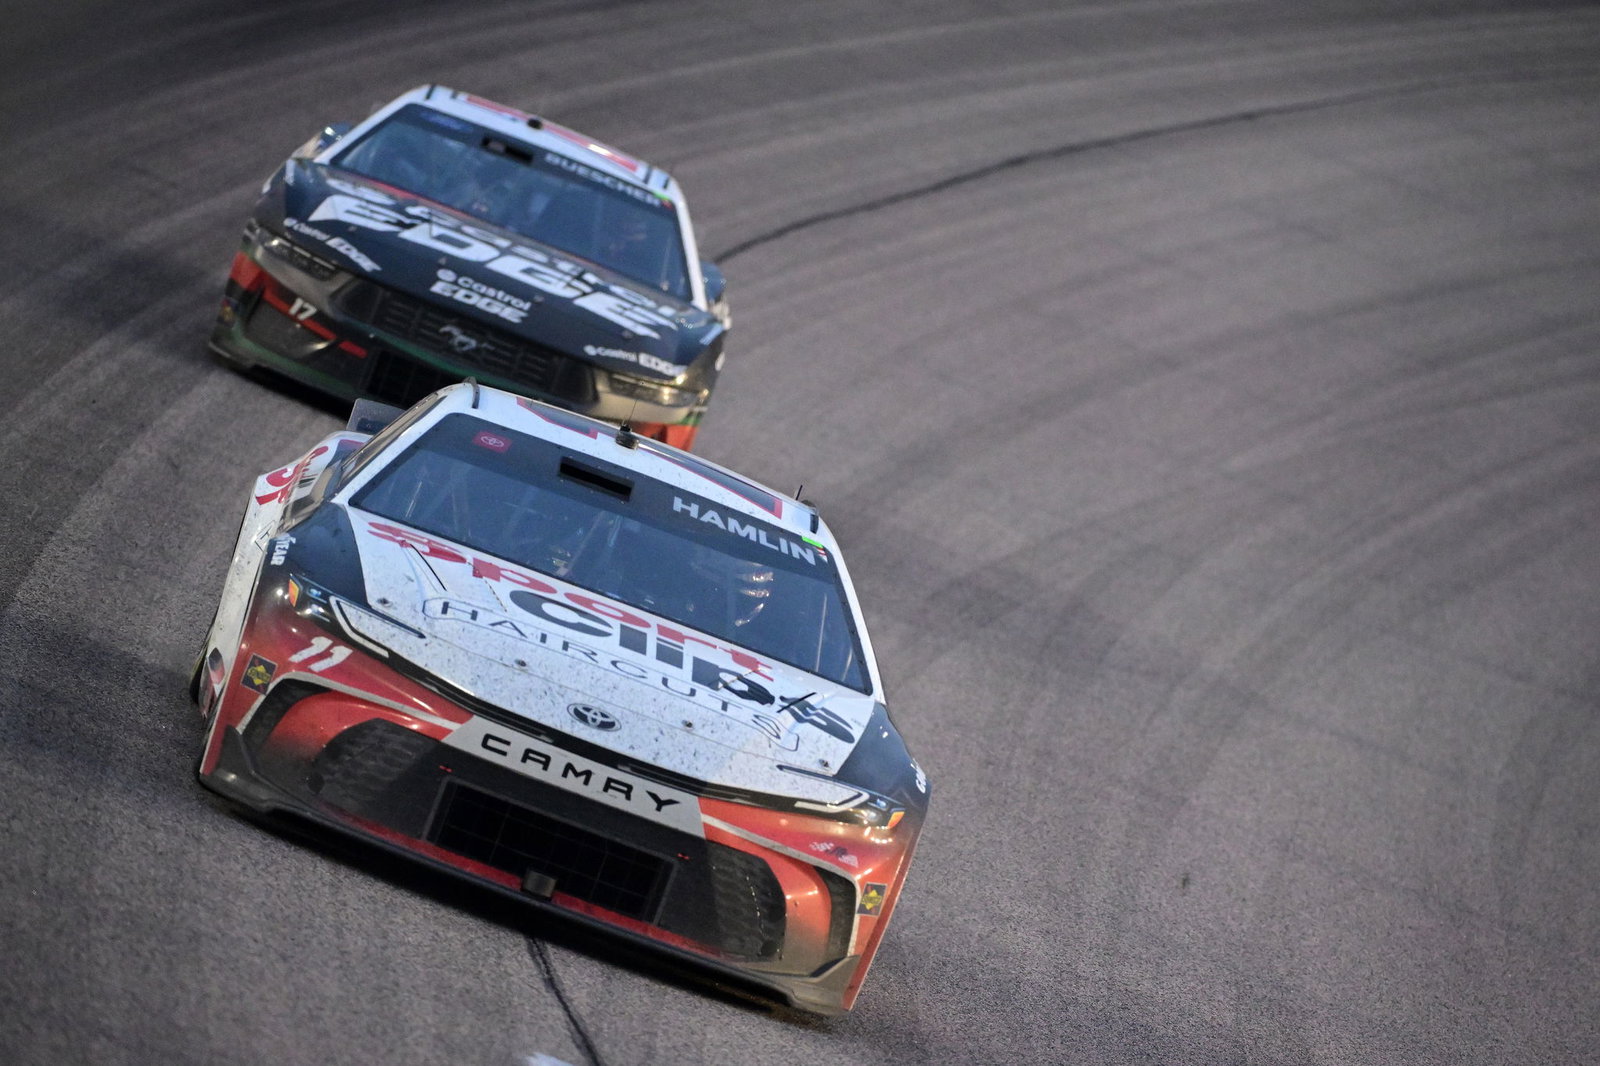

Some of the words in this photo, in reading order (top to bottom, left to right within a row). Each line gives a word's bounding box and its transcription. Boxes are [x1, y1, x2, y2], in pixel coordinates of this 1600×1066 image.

[544, 152, 662, 208] BUESCHER
[307, 194, 678, 340] EDGE
[326, 237, 382, 272] EDGE
[288, 298, 317, 320] 17
[429, 280, 530, 323] EDGE
[457, 276, 532, 311] Castrol
[672, 496, 816, 566] HAMLIN
[287, 634, 353, 672] 11
[441, 601, 783, 741] HAIRCUTS
[481, 733, 680, 812] CAMRY
